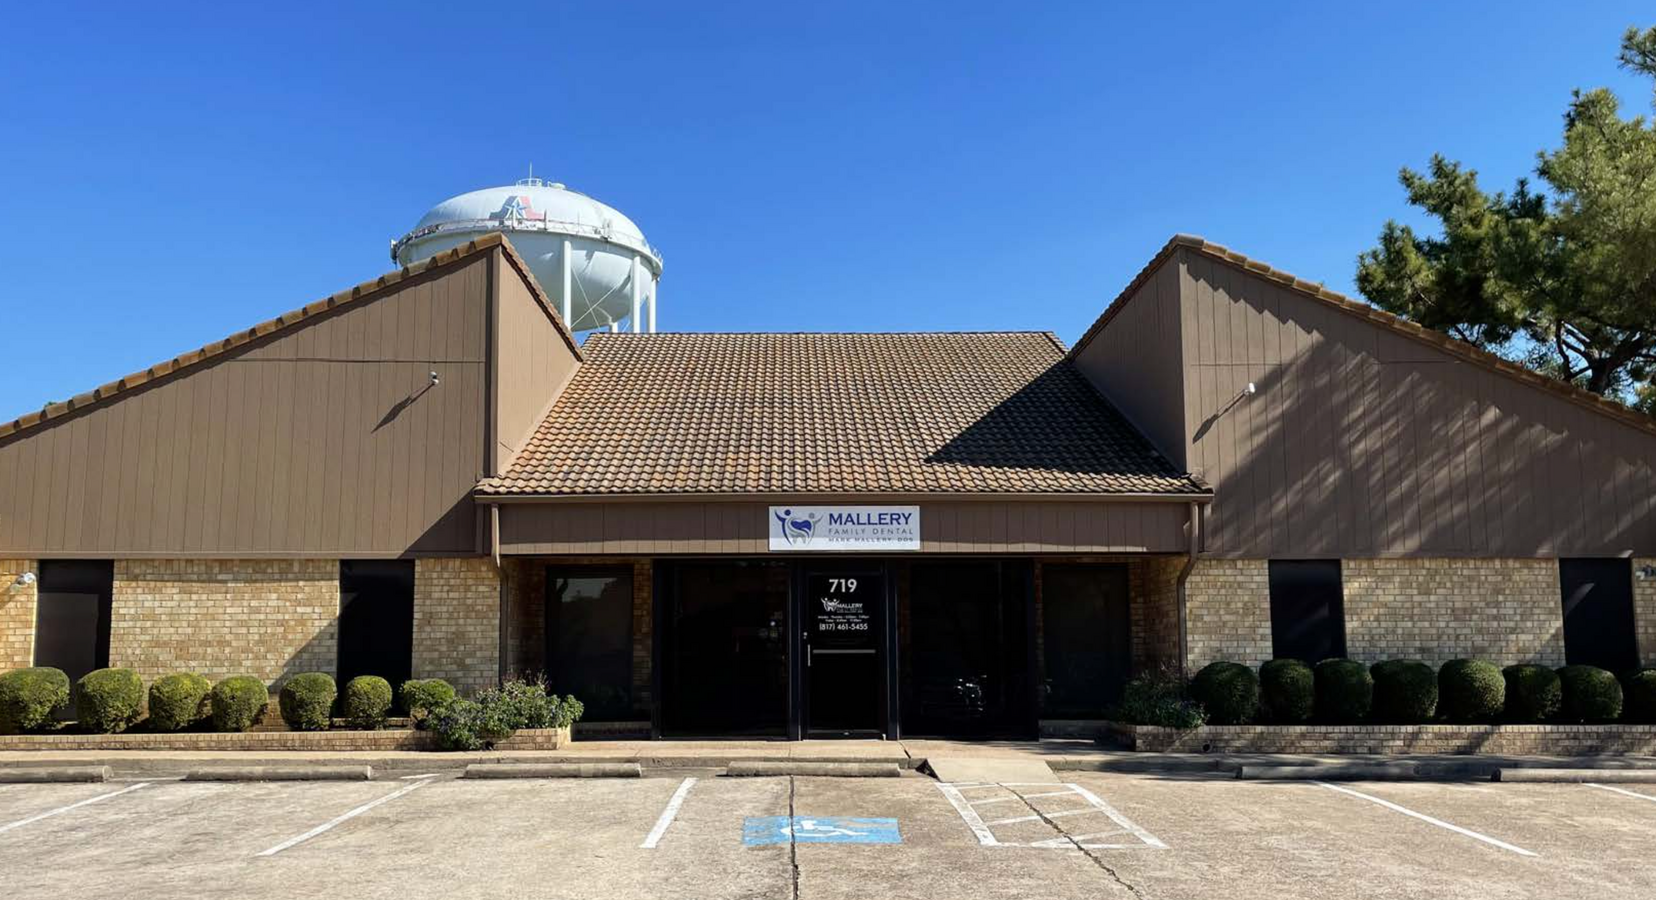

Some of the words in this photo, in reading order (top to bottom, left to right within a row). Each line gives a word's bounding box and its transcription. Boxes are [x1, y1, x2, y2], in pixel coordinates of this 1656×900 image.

[828, 512, 912, 525] MALLERY
[828, 578, 858, 593] 719
[819, 622, 836, 631] (817)
[837, 623, 868, 631] 461-5455
